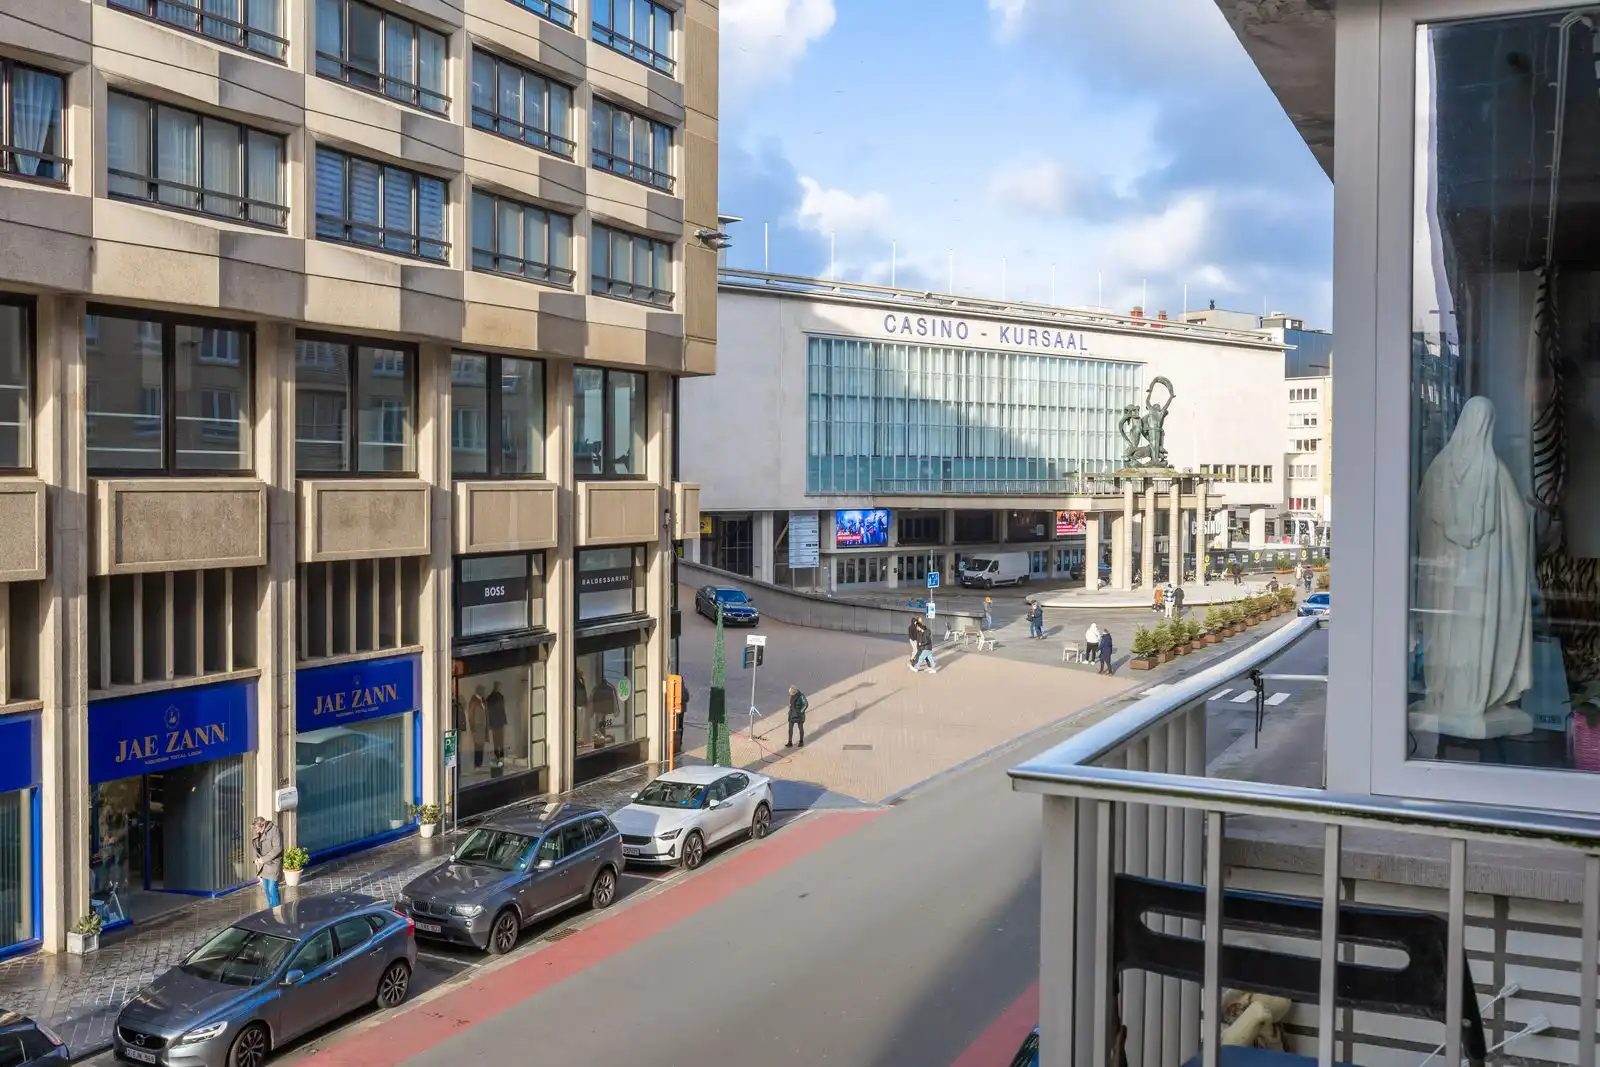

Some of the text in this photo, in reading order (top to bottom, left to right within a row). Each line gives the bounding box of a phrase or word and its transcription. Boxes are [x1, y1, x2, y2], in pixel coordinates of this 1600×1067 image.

[884, 314, 969, 340] CASINO
[999, 326, 1088, 351] KURSAAL
[1191, 519, 1222, 536] CSINO
[484, 586, 505, 597] BOSS
[581, 575, 629, 586] BALDESSARINI
[313, 692, 346, 715] JAE
[352, 683, 398, 708] ZANN
[115, 722, 227, 763] JAE ZANN
